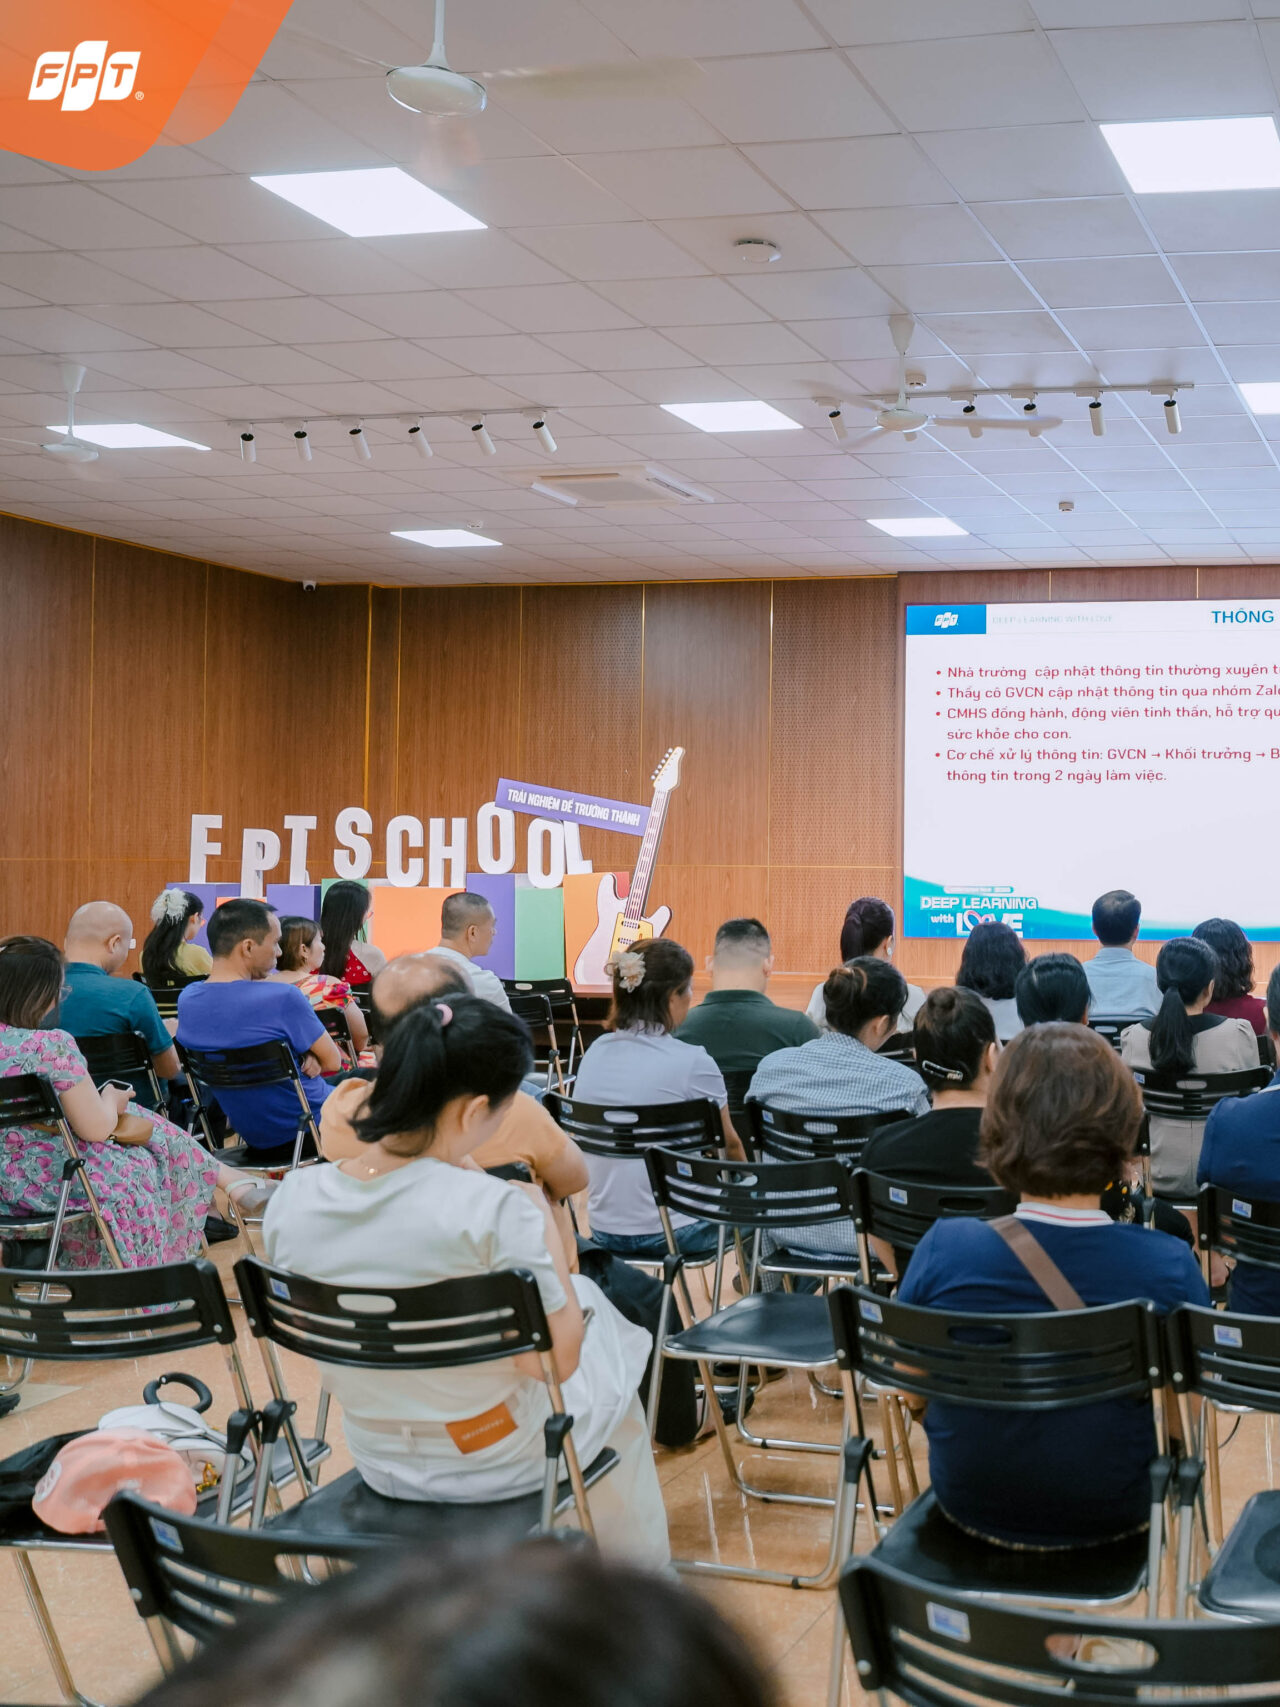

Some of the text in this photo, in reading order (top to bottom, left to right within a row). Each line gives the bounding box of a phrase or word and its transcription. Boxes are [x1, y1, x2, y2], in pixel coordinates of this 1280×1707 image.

[934, 612, 958, 628] FPT
[947, 666, 975, 678] Nhà
[978, 666, 1027, 681] trường
[1034, 665, 1060, 681] cập
[1063, 665, 1096, 680] nhật
[1099, 664, 1141, 680] thông
[1144, 664, 1164, 676] tin
[1167, 663, 1221, 679] thường
[1225, 663, 1269, 679] xuyên
[984, 686, 1002, 699] cô
[1005, 686, 1044, 699] GVCN
[1048, 686, 1074, 701] cập
[1077, 685, 1110, 700] nhật
[1112, 685, 1155, 701] thông
[1158, 685, 1178, 697] tin
[1181, 687, 1208, 700] qua
[1212, 684, 1252, 697] nhóm
[947, 707, 988, 720] CMHS
[1029, 706, 1068, 720] hành,
[1071, 706, 1107, 722] động
[1110, 706, 1140, 719] viên
[1143, 706, 1172, 718] tinh
[1215, 703, 1234, 718] hỗ
[1237, 706, 1262, 720] trợ
[946, 727, 1072, 741] sức khỏe cho con.
[946, 748, 968, 761] Cơ
[969, 747, 995, 761] chế
[998, 747, 1018, 761] xử
[1020, 748, 1033, 764] lý
[1036, 748, 1078, 764] thông
[1080, 748, 1103, 760] tin:
[1107, 748, 1147, 761] GVCN
[1165, 746, 1197, 760] Khối
[1200, 746, 1252, 763] trưởng
[946, 768, 1167, 785] thông tin trong 2 ngày làm việc.
[189, 801, 593, 898] FPT SCHOOL
[921, 896, 1039, 909] DEEP LEARNING
[930, 913, 955, 923] with
